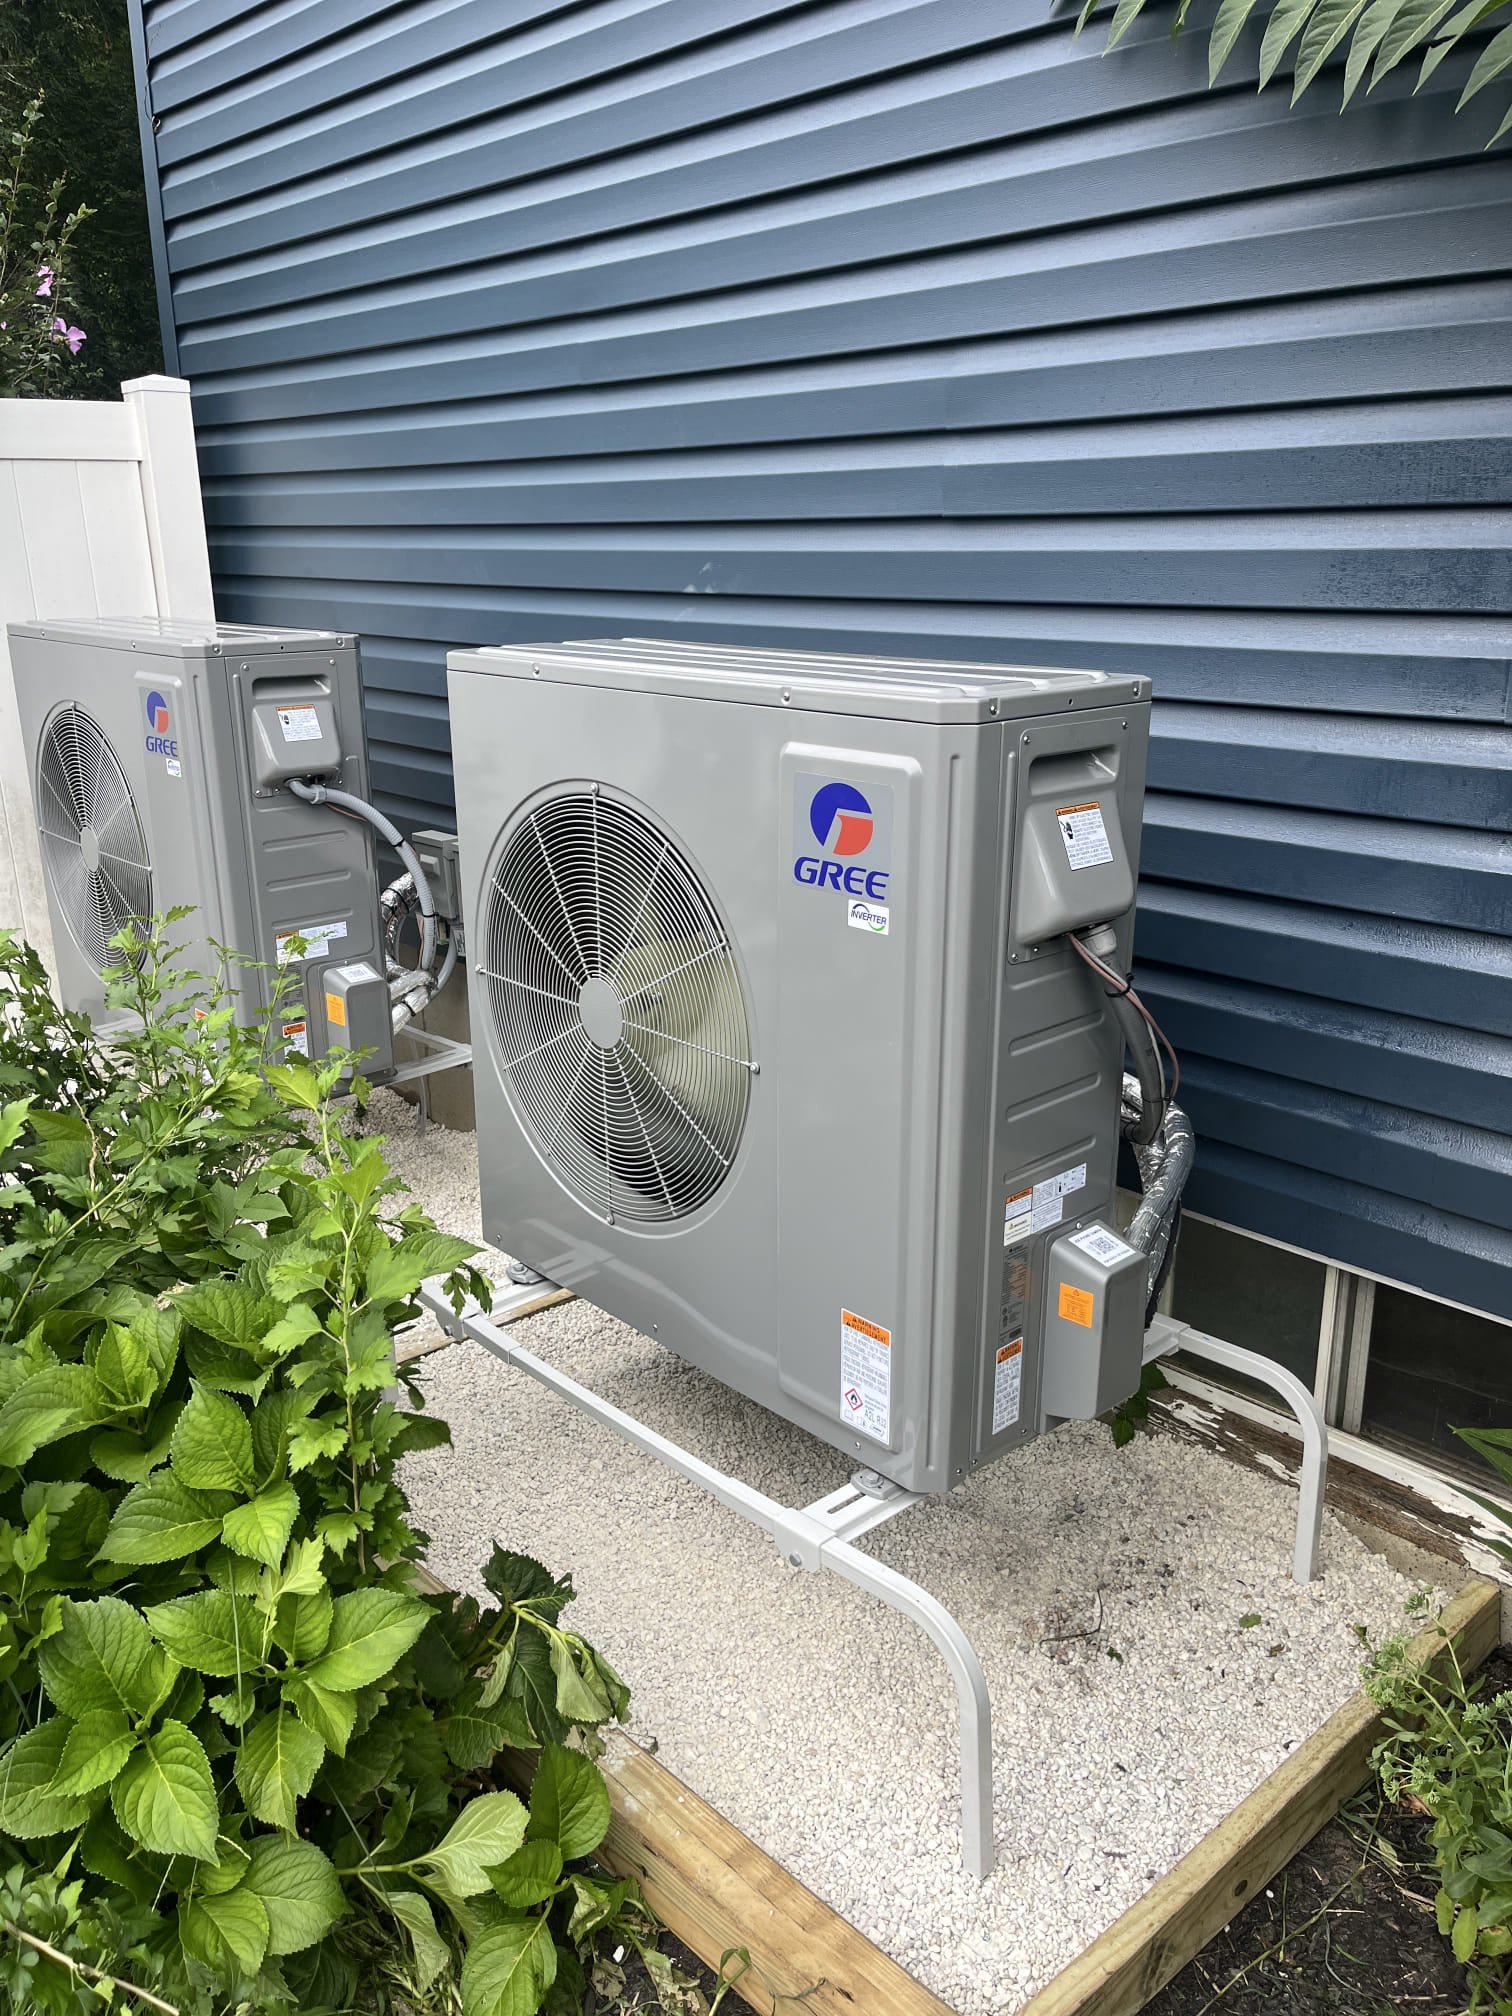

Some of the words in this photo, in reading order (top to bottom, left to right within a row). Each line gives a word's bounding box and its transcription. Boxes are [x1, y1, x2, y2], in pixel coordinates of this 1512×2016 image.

[145, 735, 178, 758] GREE
[794, 856, 890, 901] GREE
[850, 909, 887, 925] INVERTER
